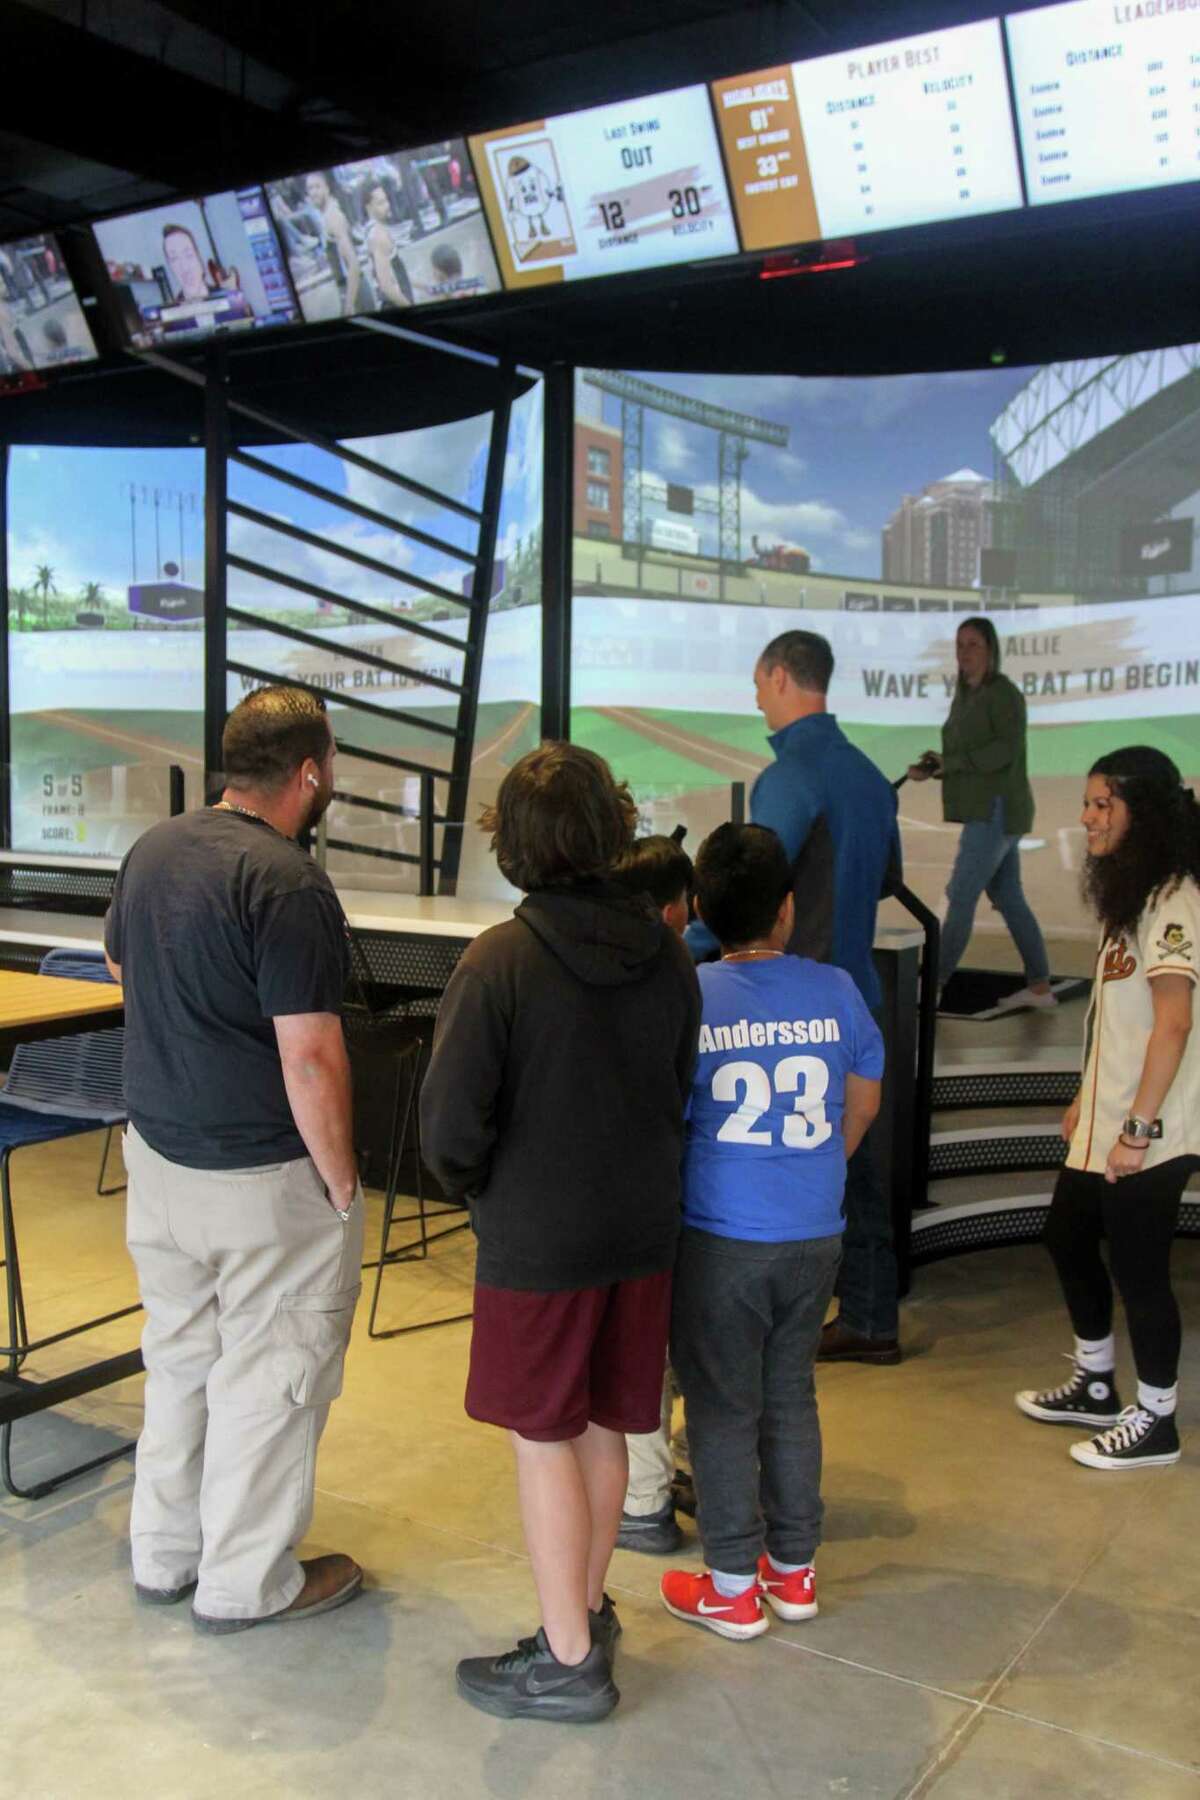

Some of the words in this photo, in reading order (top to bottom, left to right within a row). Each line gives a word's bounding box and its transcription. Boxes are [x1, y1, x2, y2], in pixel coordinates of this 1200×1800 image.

[621, 145, 653, 169] OUT
[599, 201, 625, 231] 12
[668, 186, 701, 218] 30
[1005, 635, 1060, 657] ALLIE
[353, 670, 381, 688] BAT
[862, 669, 929, 698] WAVE
[1023, 670, 1070, 696] BAT
[1083, 667, 1114, 692] TO
[1125, 660, 1200, 691] BEGIN
[698, 1017, 840, 1054] Andersson
[711, 1055, 833, 1150] 23
